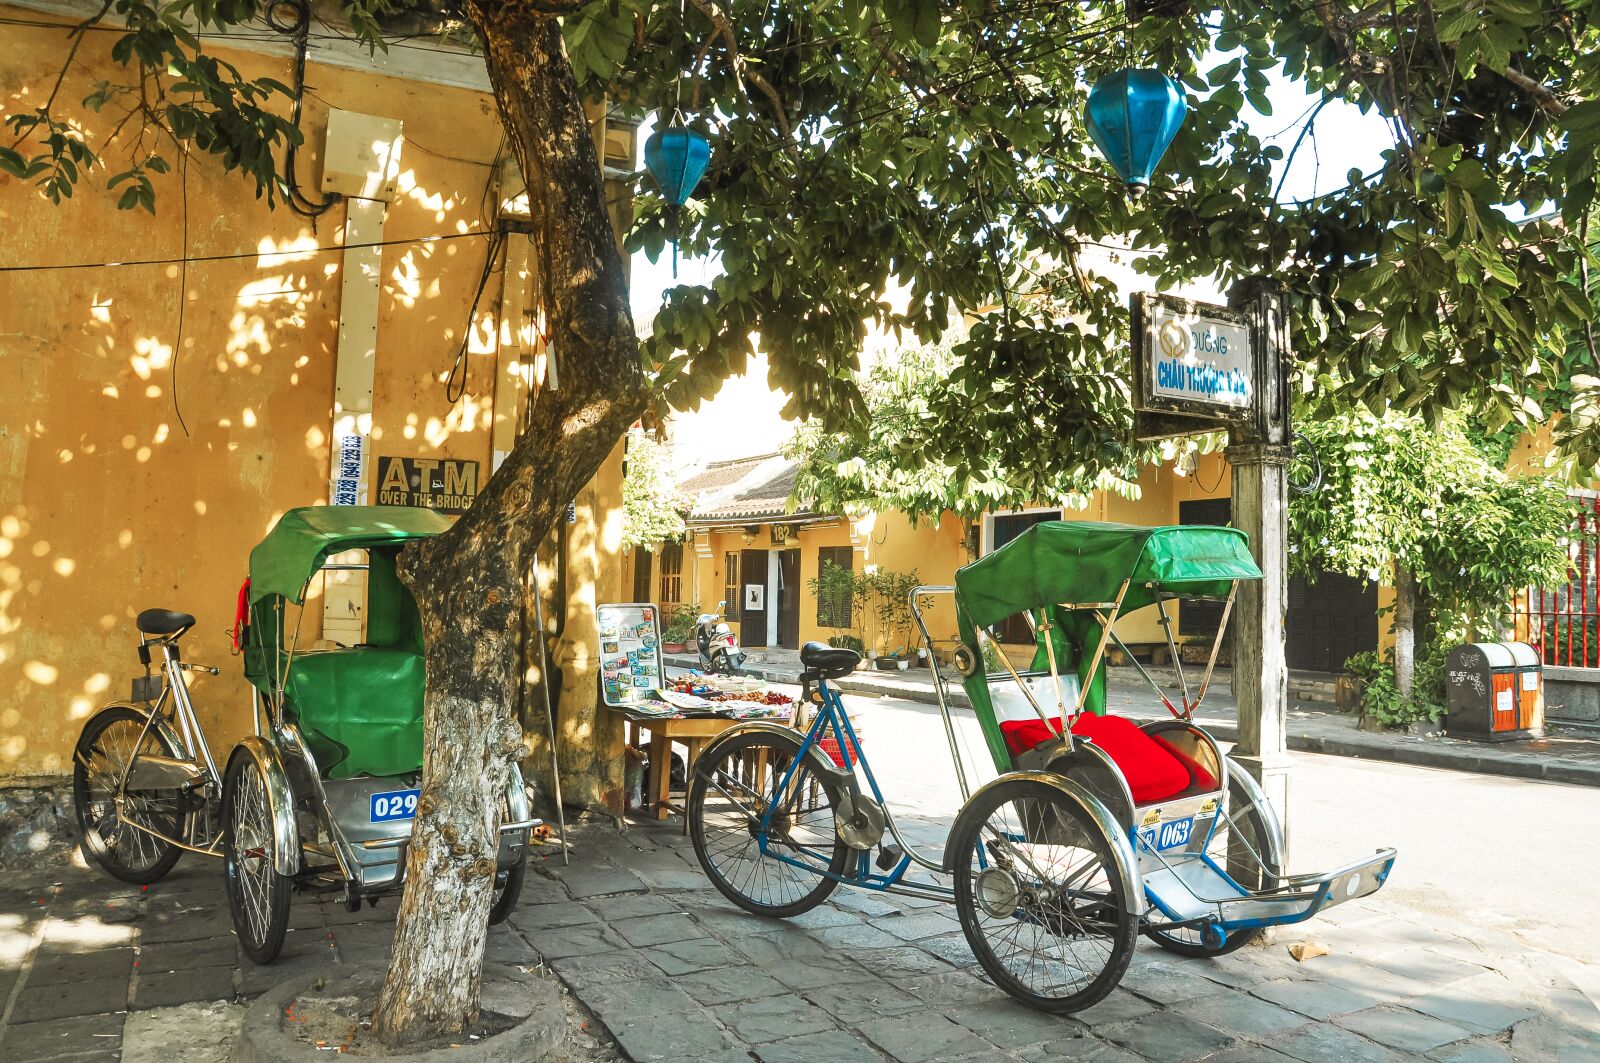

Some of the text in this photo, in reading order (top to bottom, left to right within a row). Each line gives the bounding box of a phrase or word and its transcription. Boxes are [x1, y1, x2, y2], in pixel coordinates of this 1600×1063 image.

[1157, 358, 1185, 390] CHÂU
[380, 490, 407, 506] OVER
[412, 492, 433, 508] THE
[773, 525, 790, 541] 182
[375, 794, 418, 817] 029
[1161, 820, 1190, 848] 063
